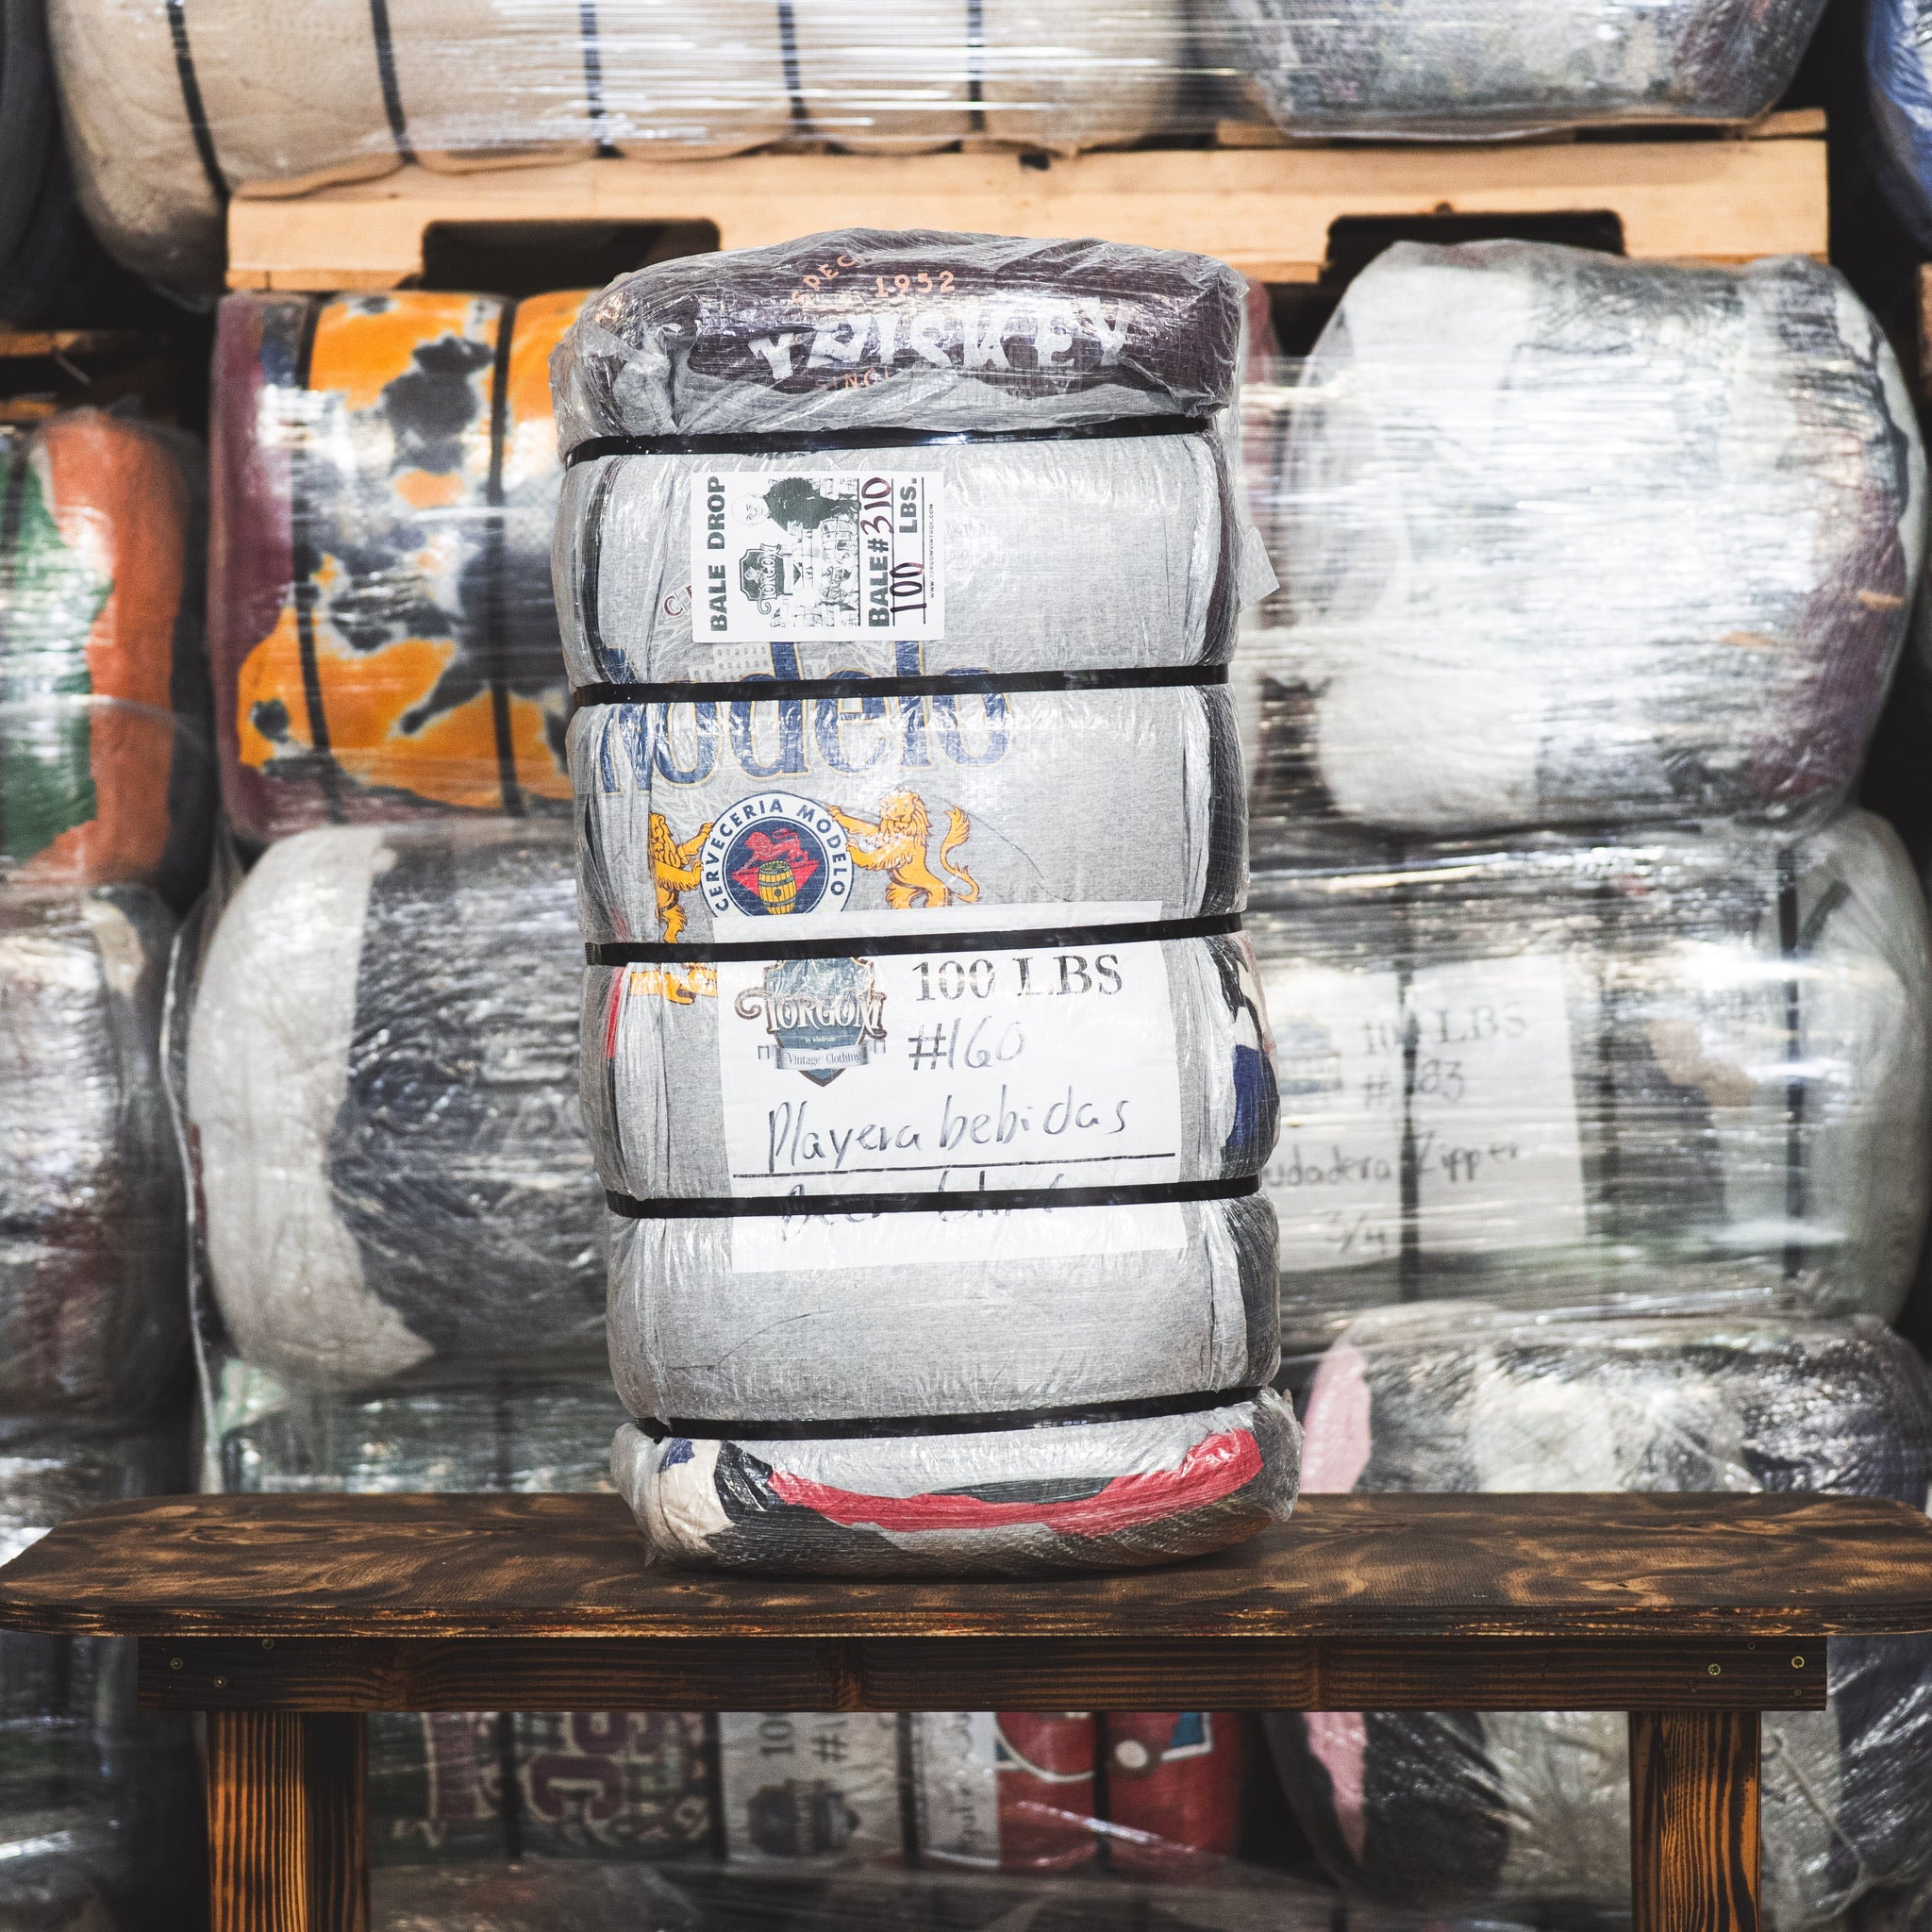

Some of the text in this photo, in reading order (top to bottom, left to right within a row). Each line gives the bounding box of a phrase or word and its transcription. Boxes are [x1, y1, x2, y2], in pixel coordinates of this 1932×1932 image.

[875, 271, 955, 298] 1952
[707, 475, 728, 632] BALE DROP
[889, 477, 927, 613] 100 LBS.
[757, 542, 783, 615] TORGOM
[715, 798, 847, 911] CERVECERIA MODELO
[911, 954, 1124, 1002] 100 LBS
[734, 986, 888, 1040] TORGOM
[785, 1049, 862, 1067] Vintage Clothing
[908, 1016, 1026, 1071] #160
[767, 1085, 1130, 1174] Playera bebidas
[1266, 1144, 1392, 1187] udadera
